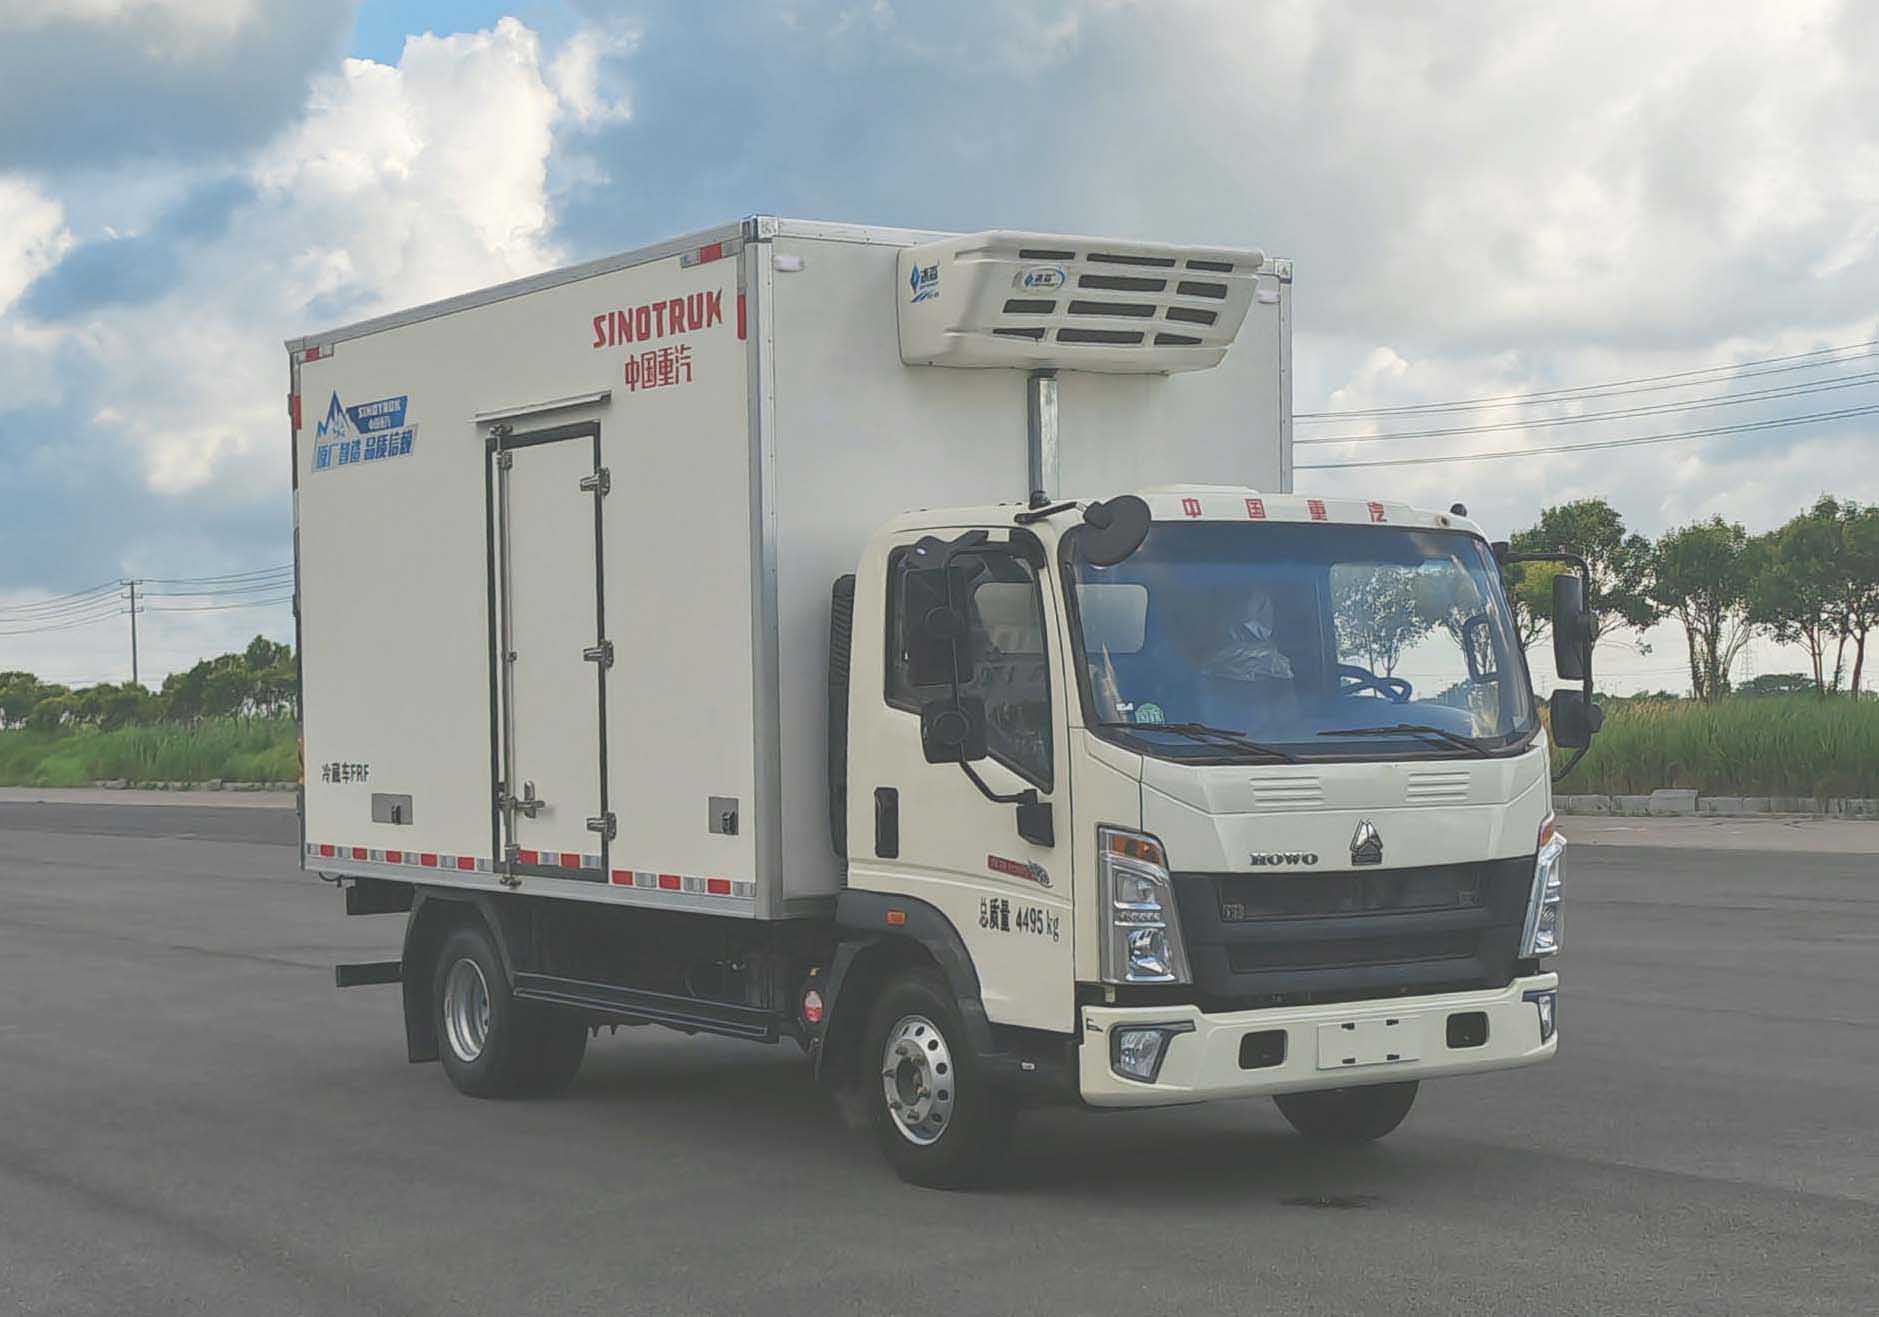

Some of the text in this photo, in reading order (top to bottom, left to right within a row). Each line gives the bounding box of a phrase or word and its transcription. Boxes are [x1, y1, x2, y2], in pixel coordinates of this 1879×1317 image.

[592, 286, 723, 349] SINOTRUK
[624, 343, 693, 392] 中国重汽
[1181, 497, 1388, 523] 中国重汽
[1250, 852, 1319, 867] HOWO
[978, 896, 1060, 943] 总质量 4495 kg
